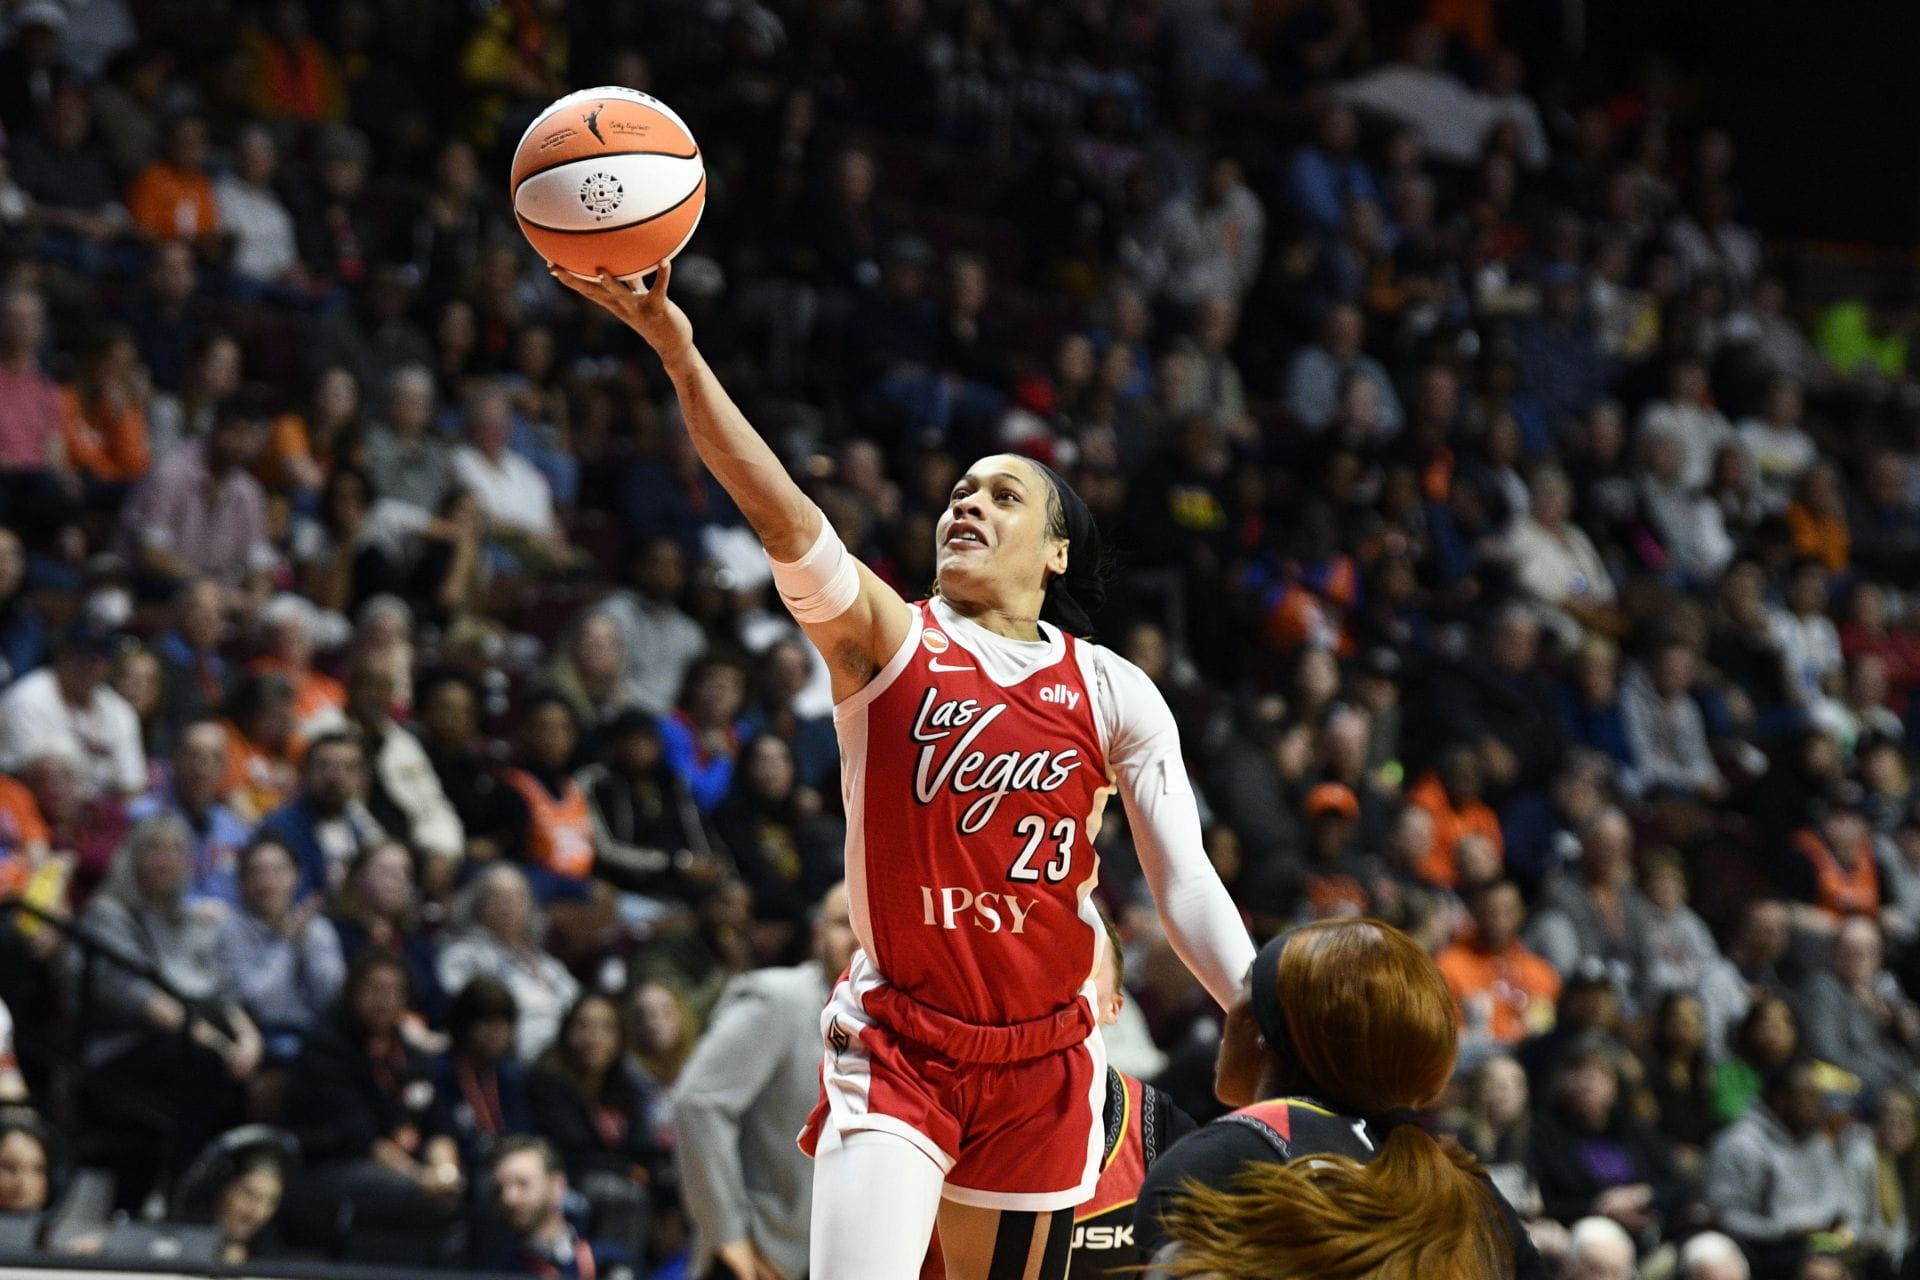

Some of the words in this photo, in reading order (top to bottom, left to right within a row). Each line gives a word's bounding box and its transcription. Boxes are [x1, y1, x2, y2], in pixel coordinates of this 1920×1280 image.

[911, 686, 982, 743] Las
[1039, 684, 1080, 711] ally
[914, 704, 1083, 834] Vegas
[1008, 814, 1077, 885] 23
[920, 886, 1040, 934] IPSY
